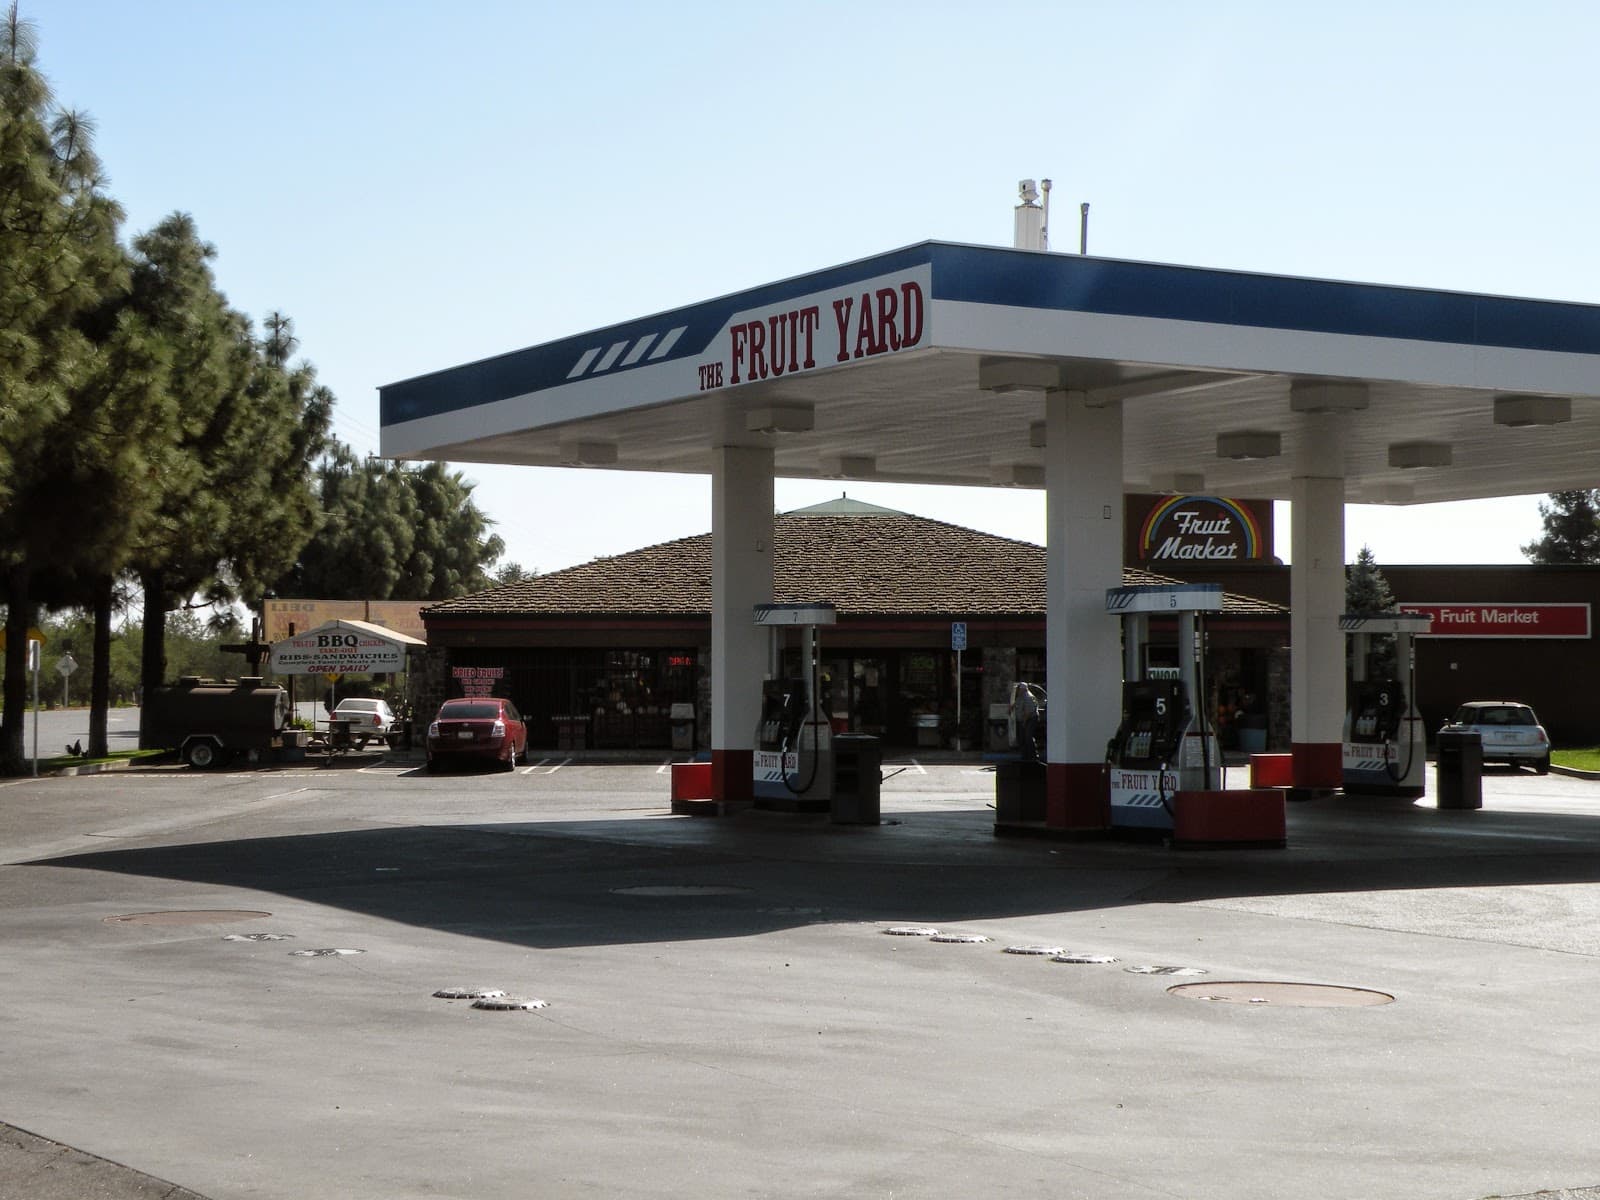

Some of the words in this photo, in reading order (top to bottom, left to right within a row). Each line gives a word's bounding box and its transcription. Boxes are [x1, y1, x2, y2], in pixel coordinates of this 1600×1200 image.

[698, 361, 723, 391] THE
[730, 305, 820, 385] FRUIT
[832, 281, 924, 362] YARD
[1173, 511, 1231, 534] Fruit
[1152, 536, 1238, 559] Market
[1170, 595, 1177, 608] 5
[793, 611, 798, 623] 7
[1440, 608, 1476, 623] Fruit
[1481, 608, 1539, 623] Market
[317, 634, 358, 647] BBQ
[308, 665, 336, 673] OPEN
[783, 693, 791, 708] 7
[1156, 698, 1167, 715] 5
[1379, 693, 1389, 706] 3
[1121, 774, 1149, 790] FRUIT
[1152, 775, 1177, 791] YRD
